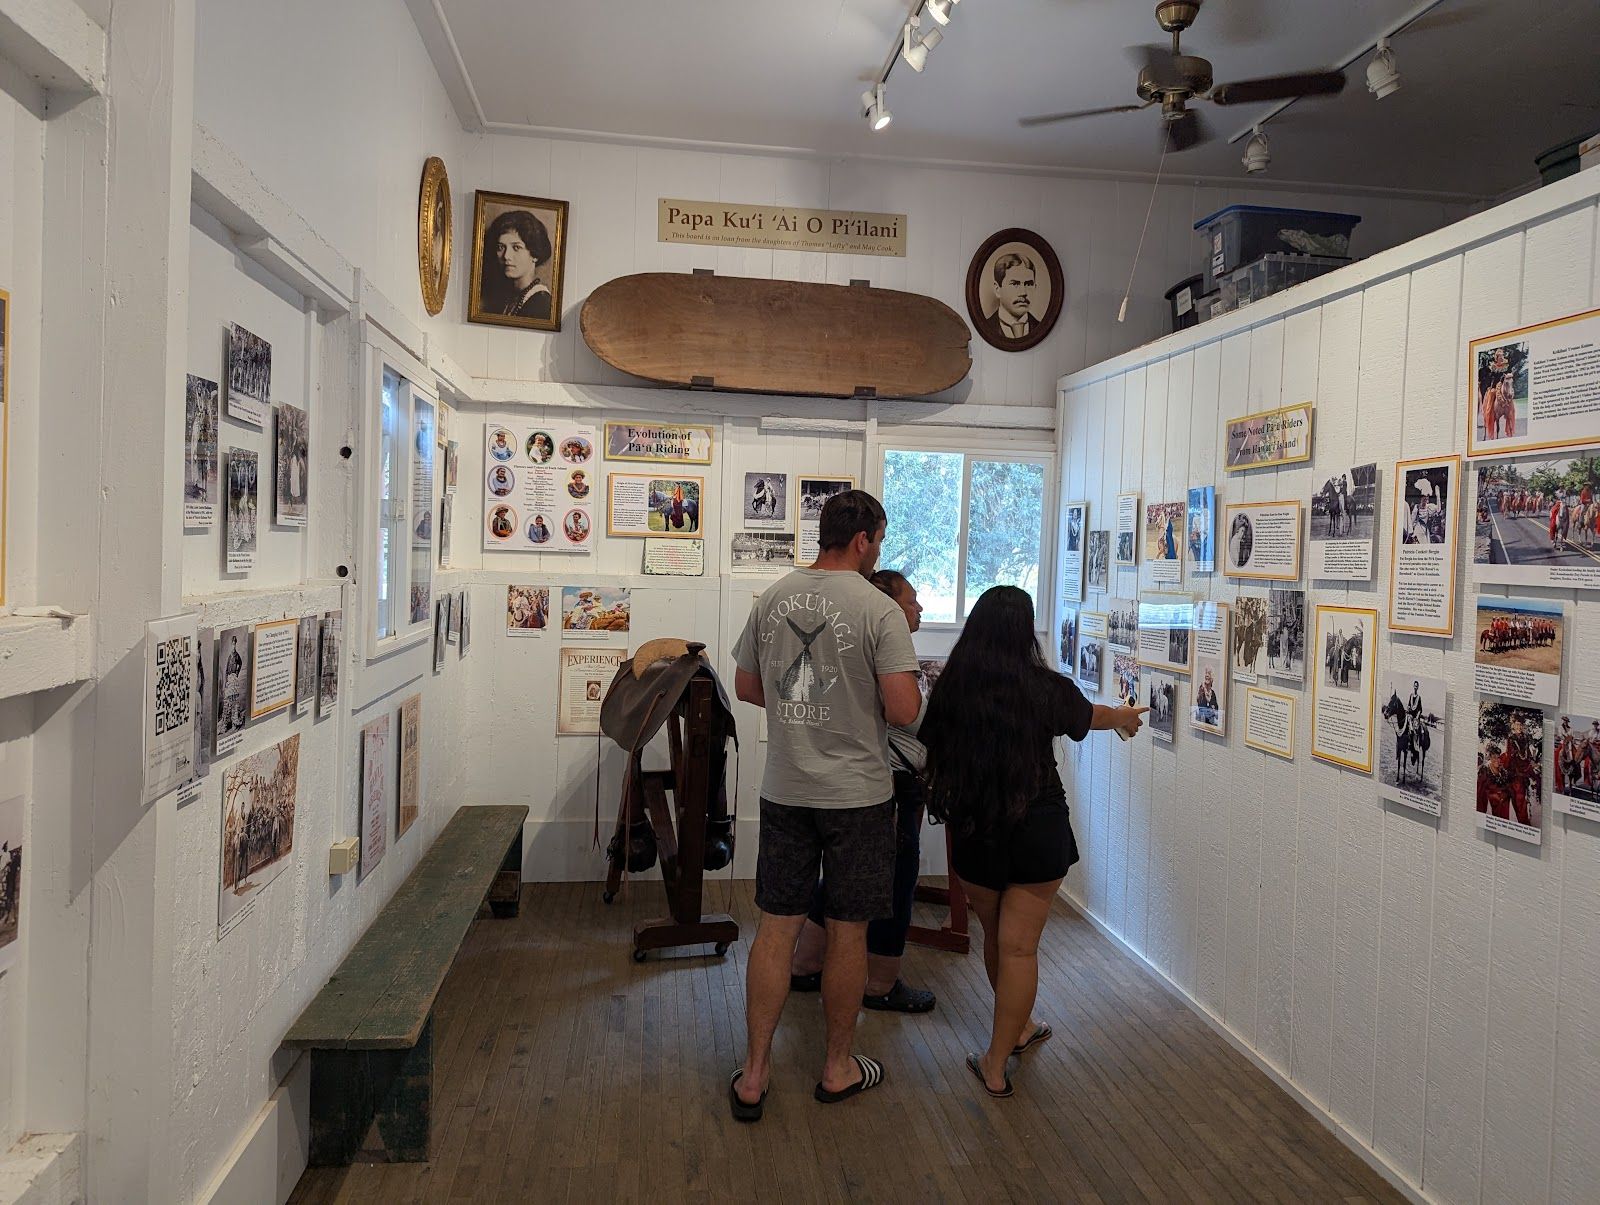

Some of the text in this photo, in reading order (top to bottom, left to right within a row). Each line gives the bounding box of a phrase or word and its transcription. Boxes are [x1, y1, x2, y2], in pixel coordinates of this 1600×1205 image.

[667, 207, 714, 231] Papa
[806, 217, 823, 233] O
[672, 231, 685, 239] This
[686, 232, 704, 240] board
[735, 236, 751, 244] from
[751, 236, 761, 244] the
[762, 237, 792, 246] daughters
[792, 239, 800, 247] of
[628, 429, 692, 440] Evolution of
[1231, 430, 1247, 440] Some
[1248, 425, 1264, 436] Noted
[1282, 418, 1303, 430] Riders
[655, 443, 690, 456] Riding
[766, 593, 855, 654] TOKUNAGA
[821, 665, 838, 673] 1920
[776, 700, 831, 721] STORE
